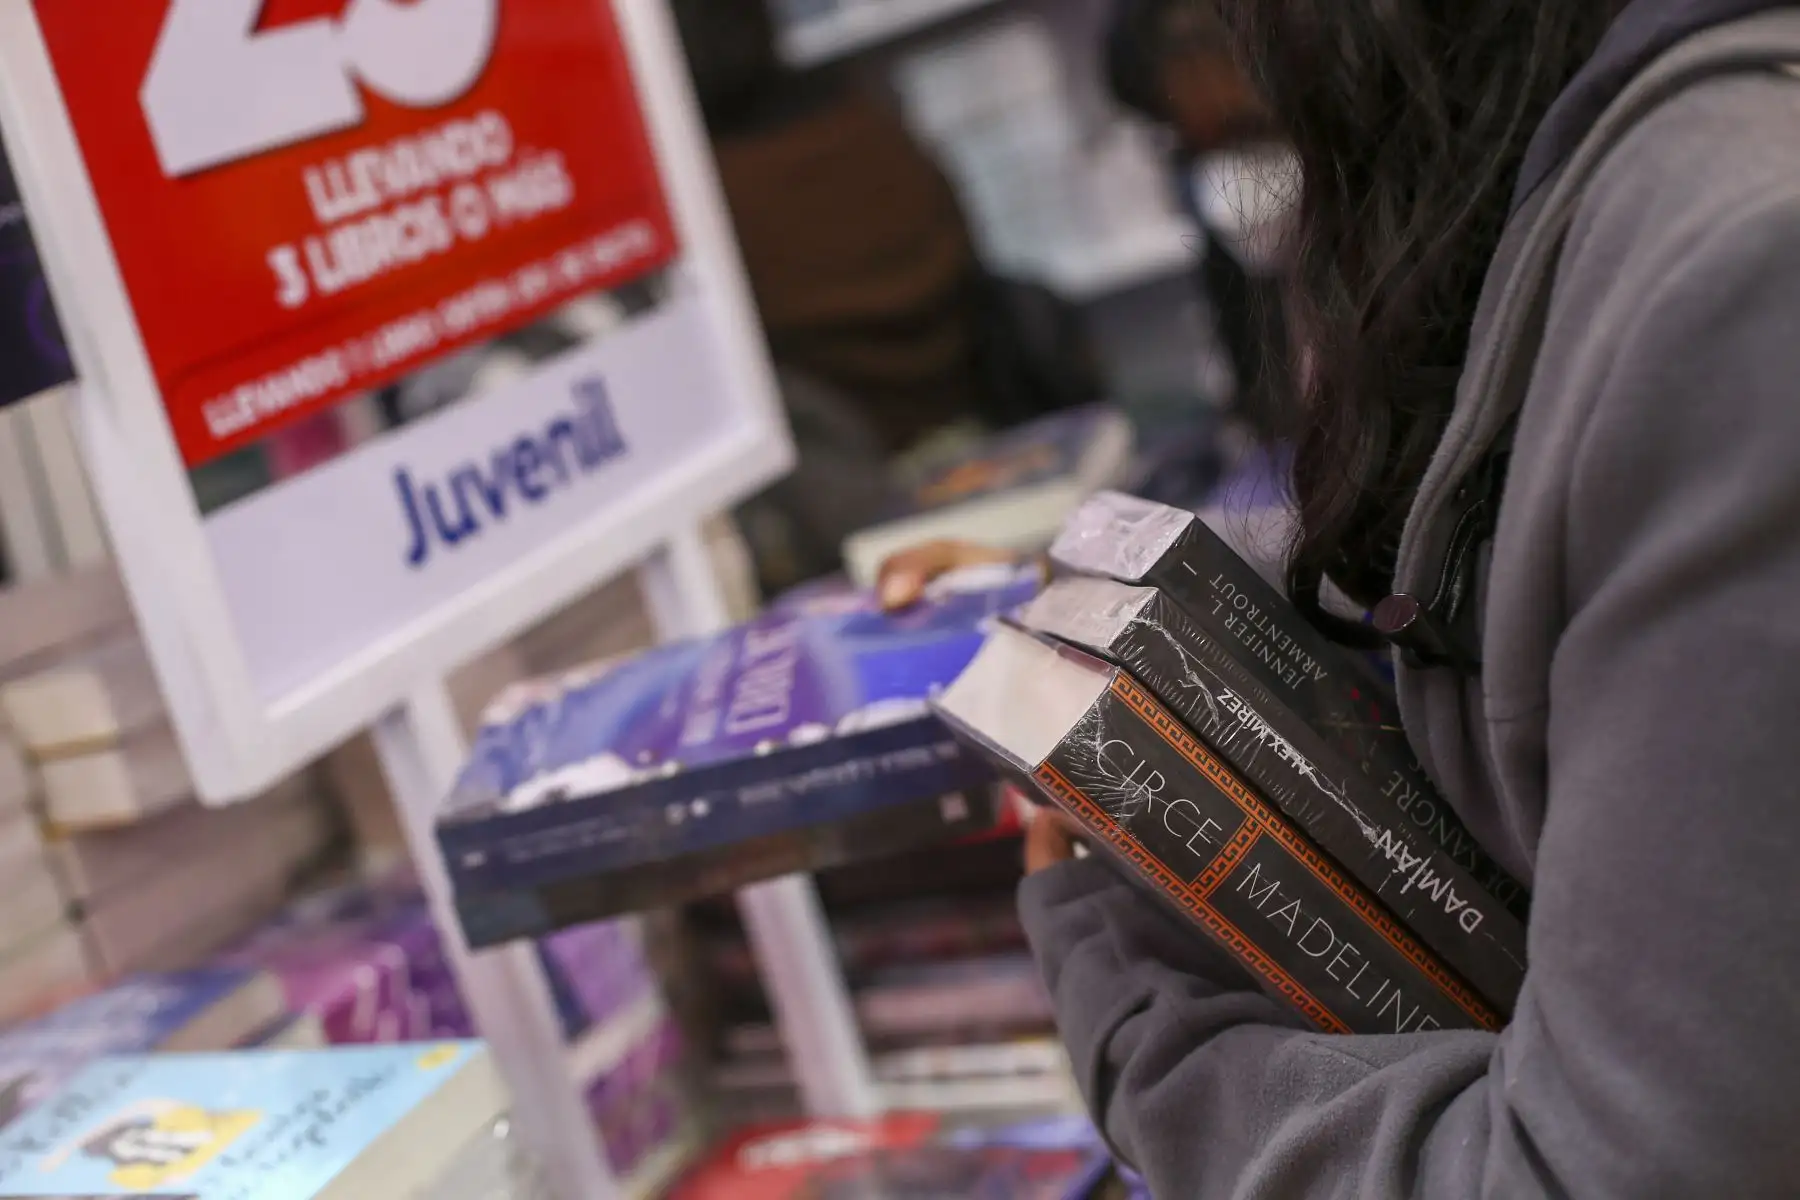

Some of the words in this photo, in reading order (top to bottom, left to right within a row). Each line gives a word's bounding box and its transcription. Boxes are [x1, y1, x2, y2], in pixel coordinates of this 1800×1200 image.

[303, 110, 511, 222] LLEVANDO
[392, 377, 628, 566] Juvenil
[1209, 573, 1328, 681] ARMENTROUT
[1210, 594, 1223, 615] L.
[1224, 612, 1307, 690] JENNIFER
[1216, 687, 1270, 740] MÍREZ
[1267, 735, 1316, 775] ALEX
[1097, 739, 1222, 857] CIRCE
[1373, 828, 1484, 934] DAMIÁN
